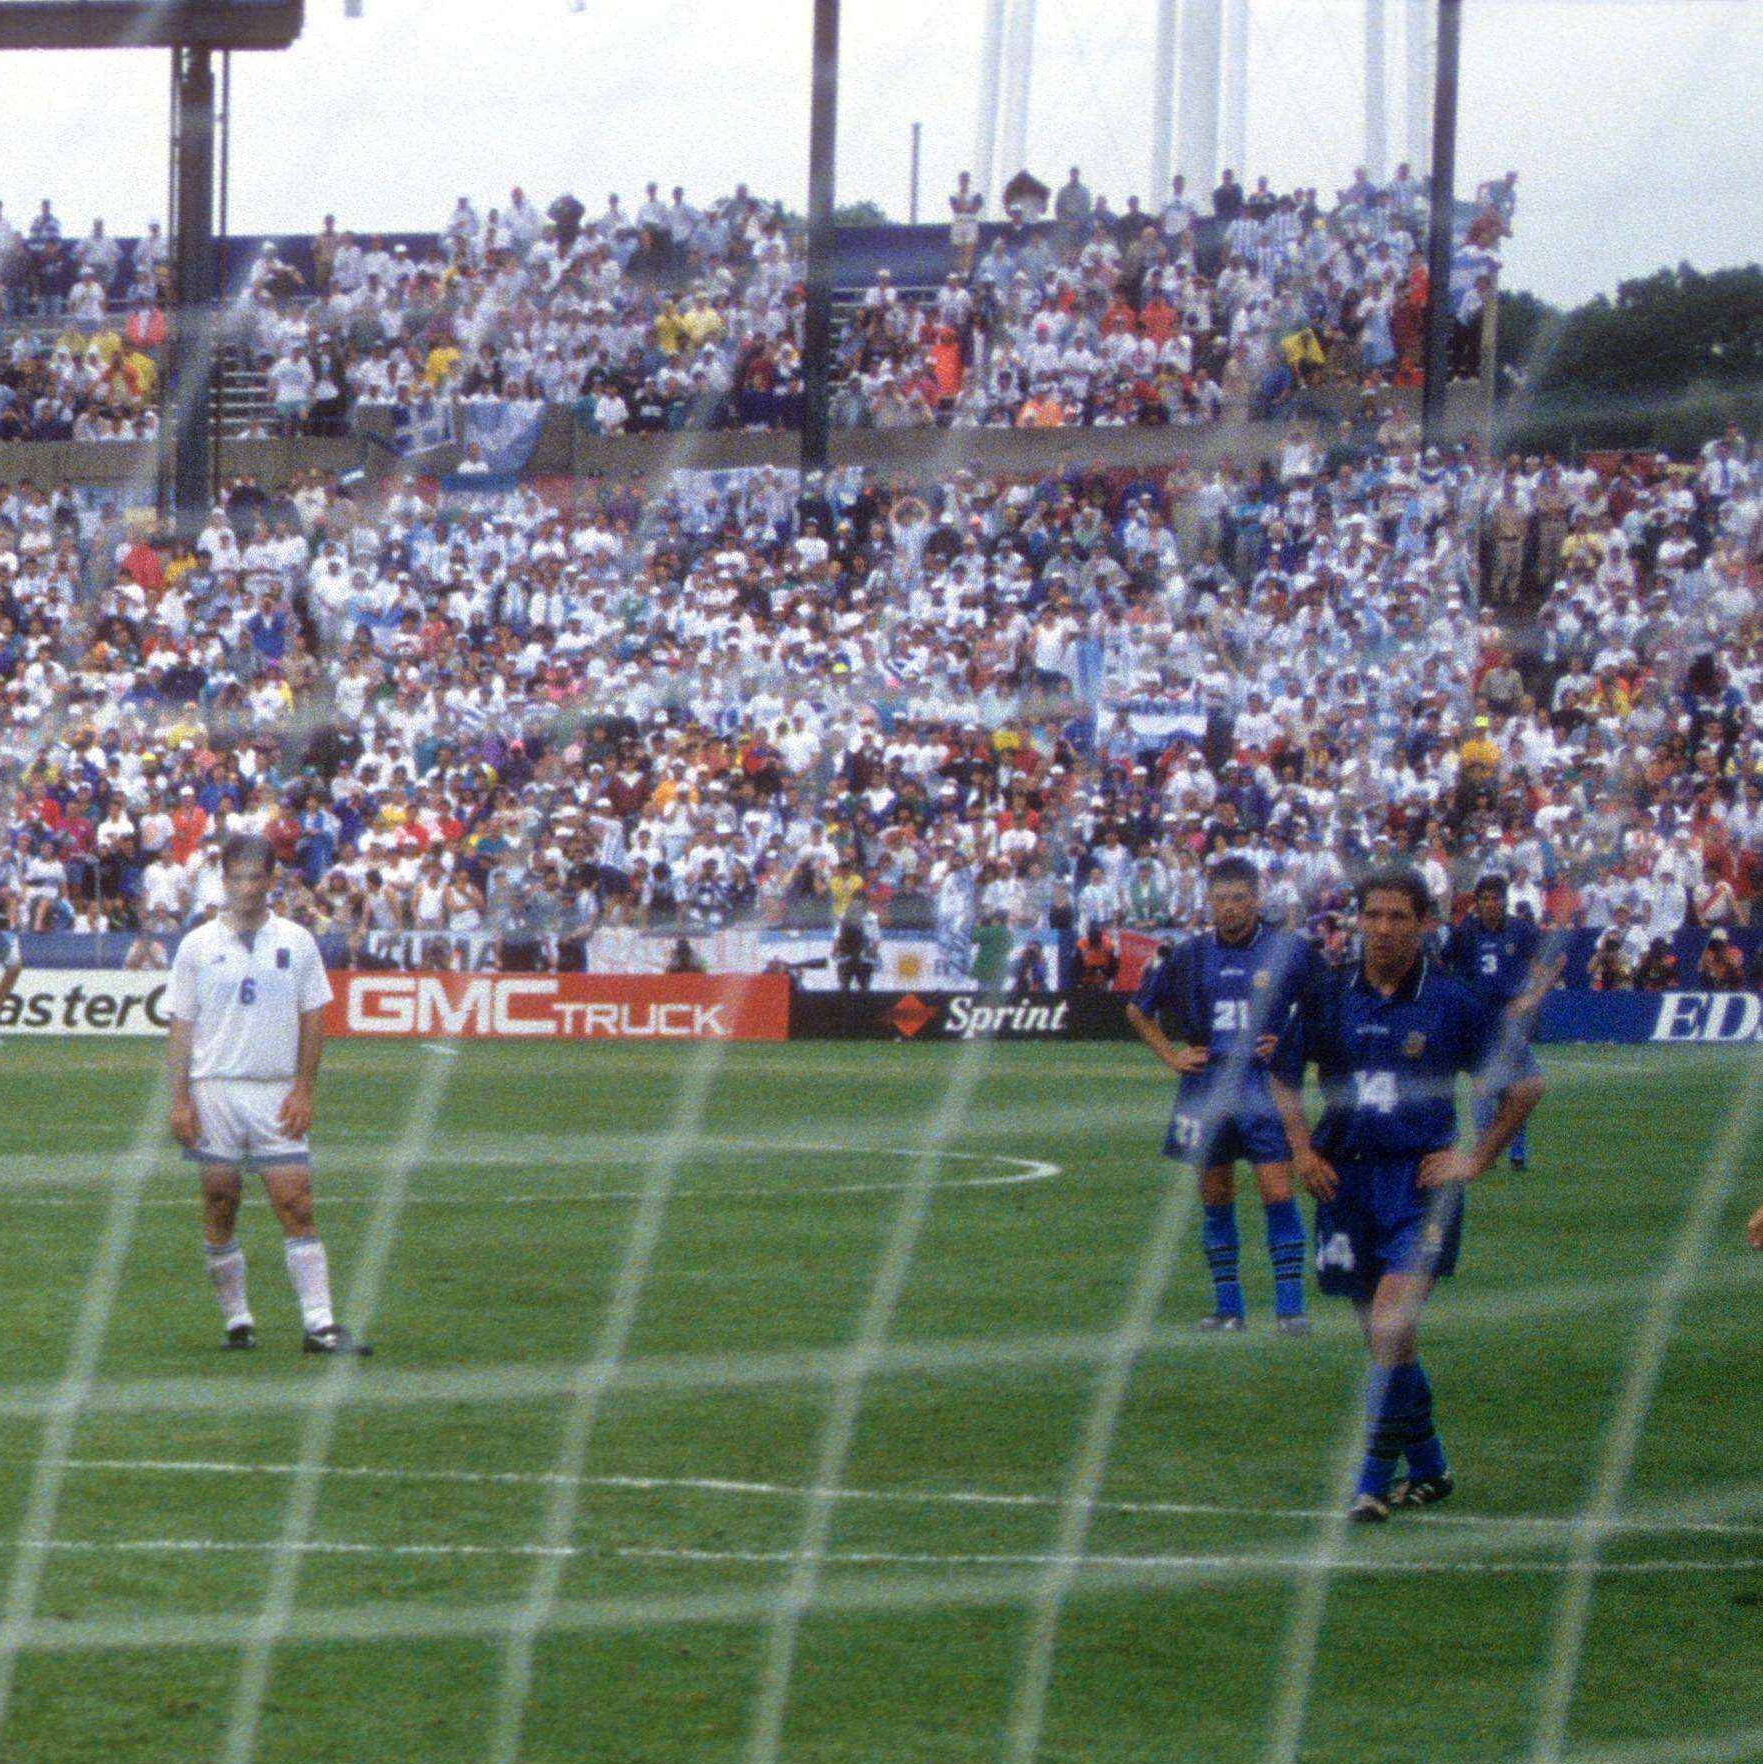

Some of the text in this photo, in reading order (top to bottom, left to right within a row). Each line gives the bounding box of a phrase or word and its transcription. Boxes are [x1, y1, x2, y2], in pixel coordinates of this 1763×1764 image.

[1480, 952, 1498, 974] 3
[238, 976, 257, 1004] 6
[347, 976, 728, 1036] GMC TRUCK
[944, 996, 1070, 1040] Sprint
[1212, 999, 1250, 1031] 21
[1649, 991, 1763, 1041] ED
